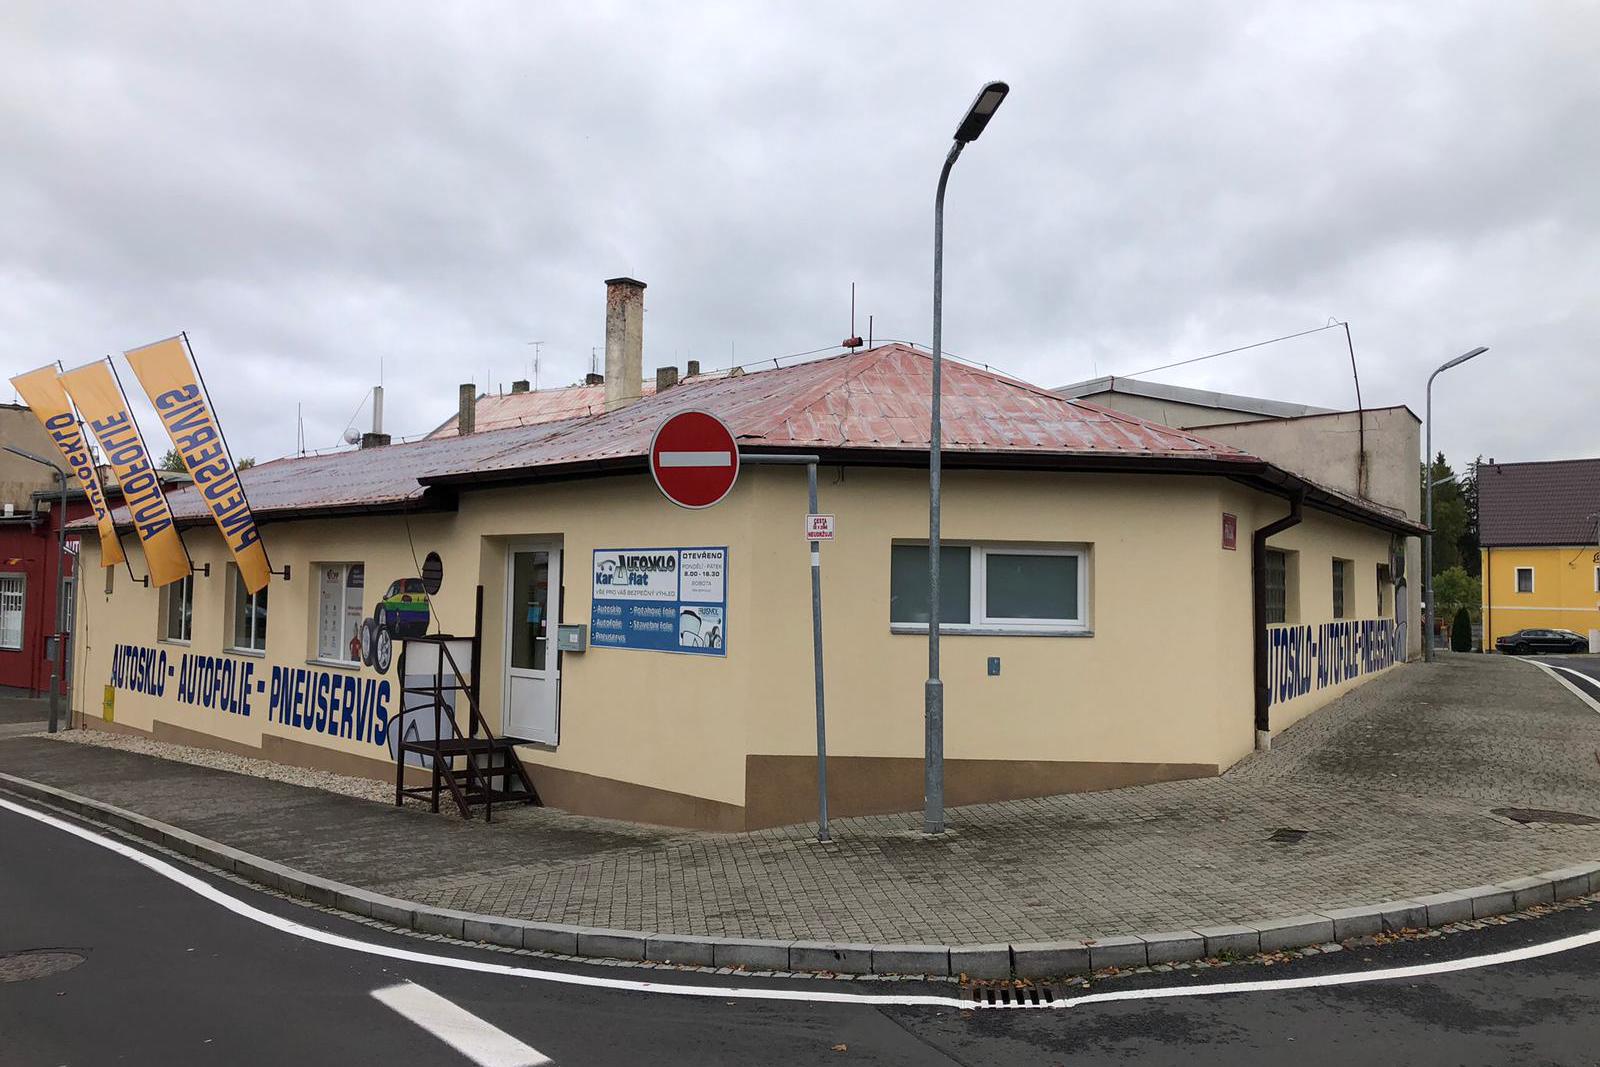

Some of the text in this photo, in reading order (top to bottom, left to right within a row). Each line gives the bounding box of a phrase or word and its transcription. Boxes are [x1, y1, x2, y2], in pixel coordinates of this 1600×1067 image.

[682, 551, 722, 559] OTEVŘENO
[111, 643, 167, 697] AUTOSKLO
[178, 653, 254, 717] AUTOFOLIE
[268, 665, 391, 746] PNEUSERVIS
[1266, 624, 1312, 708] UTOSKLO
[1317, 620, 1359, 690] AUTOFOLIE
